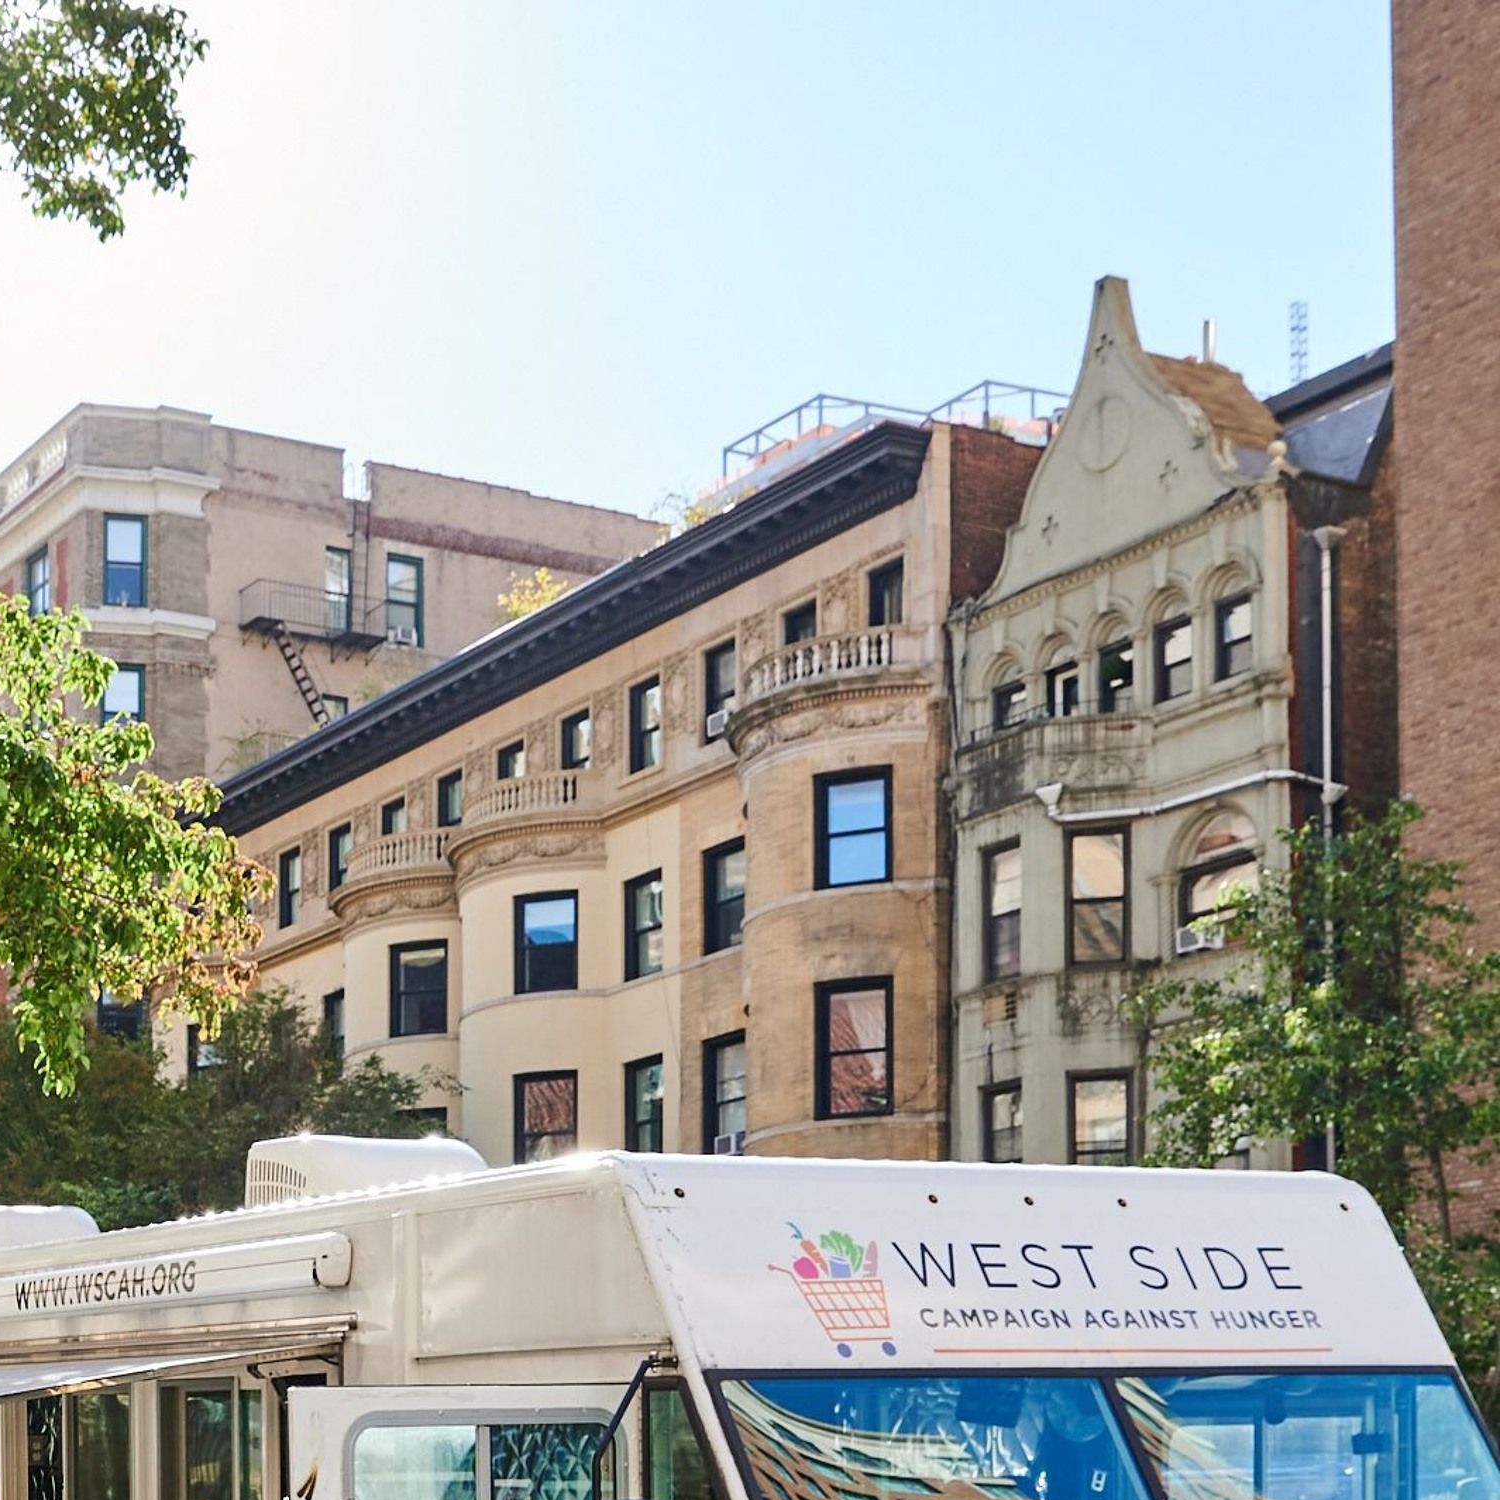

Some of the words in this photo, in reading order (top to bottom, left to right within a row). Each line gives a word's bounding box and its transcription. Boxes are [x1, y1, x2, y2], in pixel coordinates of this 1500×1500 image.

[15, 1260, 196, 1311] WWW.WSCAH.ORG
[892, 1242, 1098, 1289] WEST
[1129, 1245, 1302, 1290] SIDE
[920, 1308, 1071, 1329] CAMPAIGN
[1084, 1308, 1198, 1329] AGAINST
[1213, 1309, 1322, 1330] HUNGER
